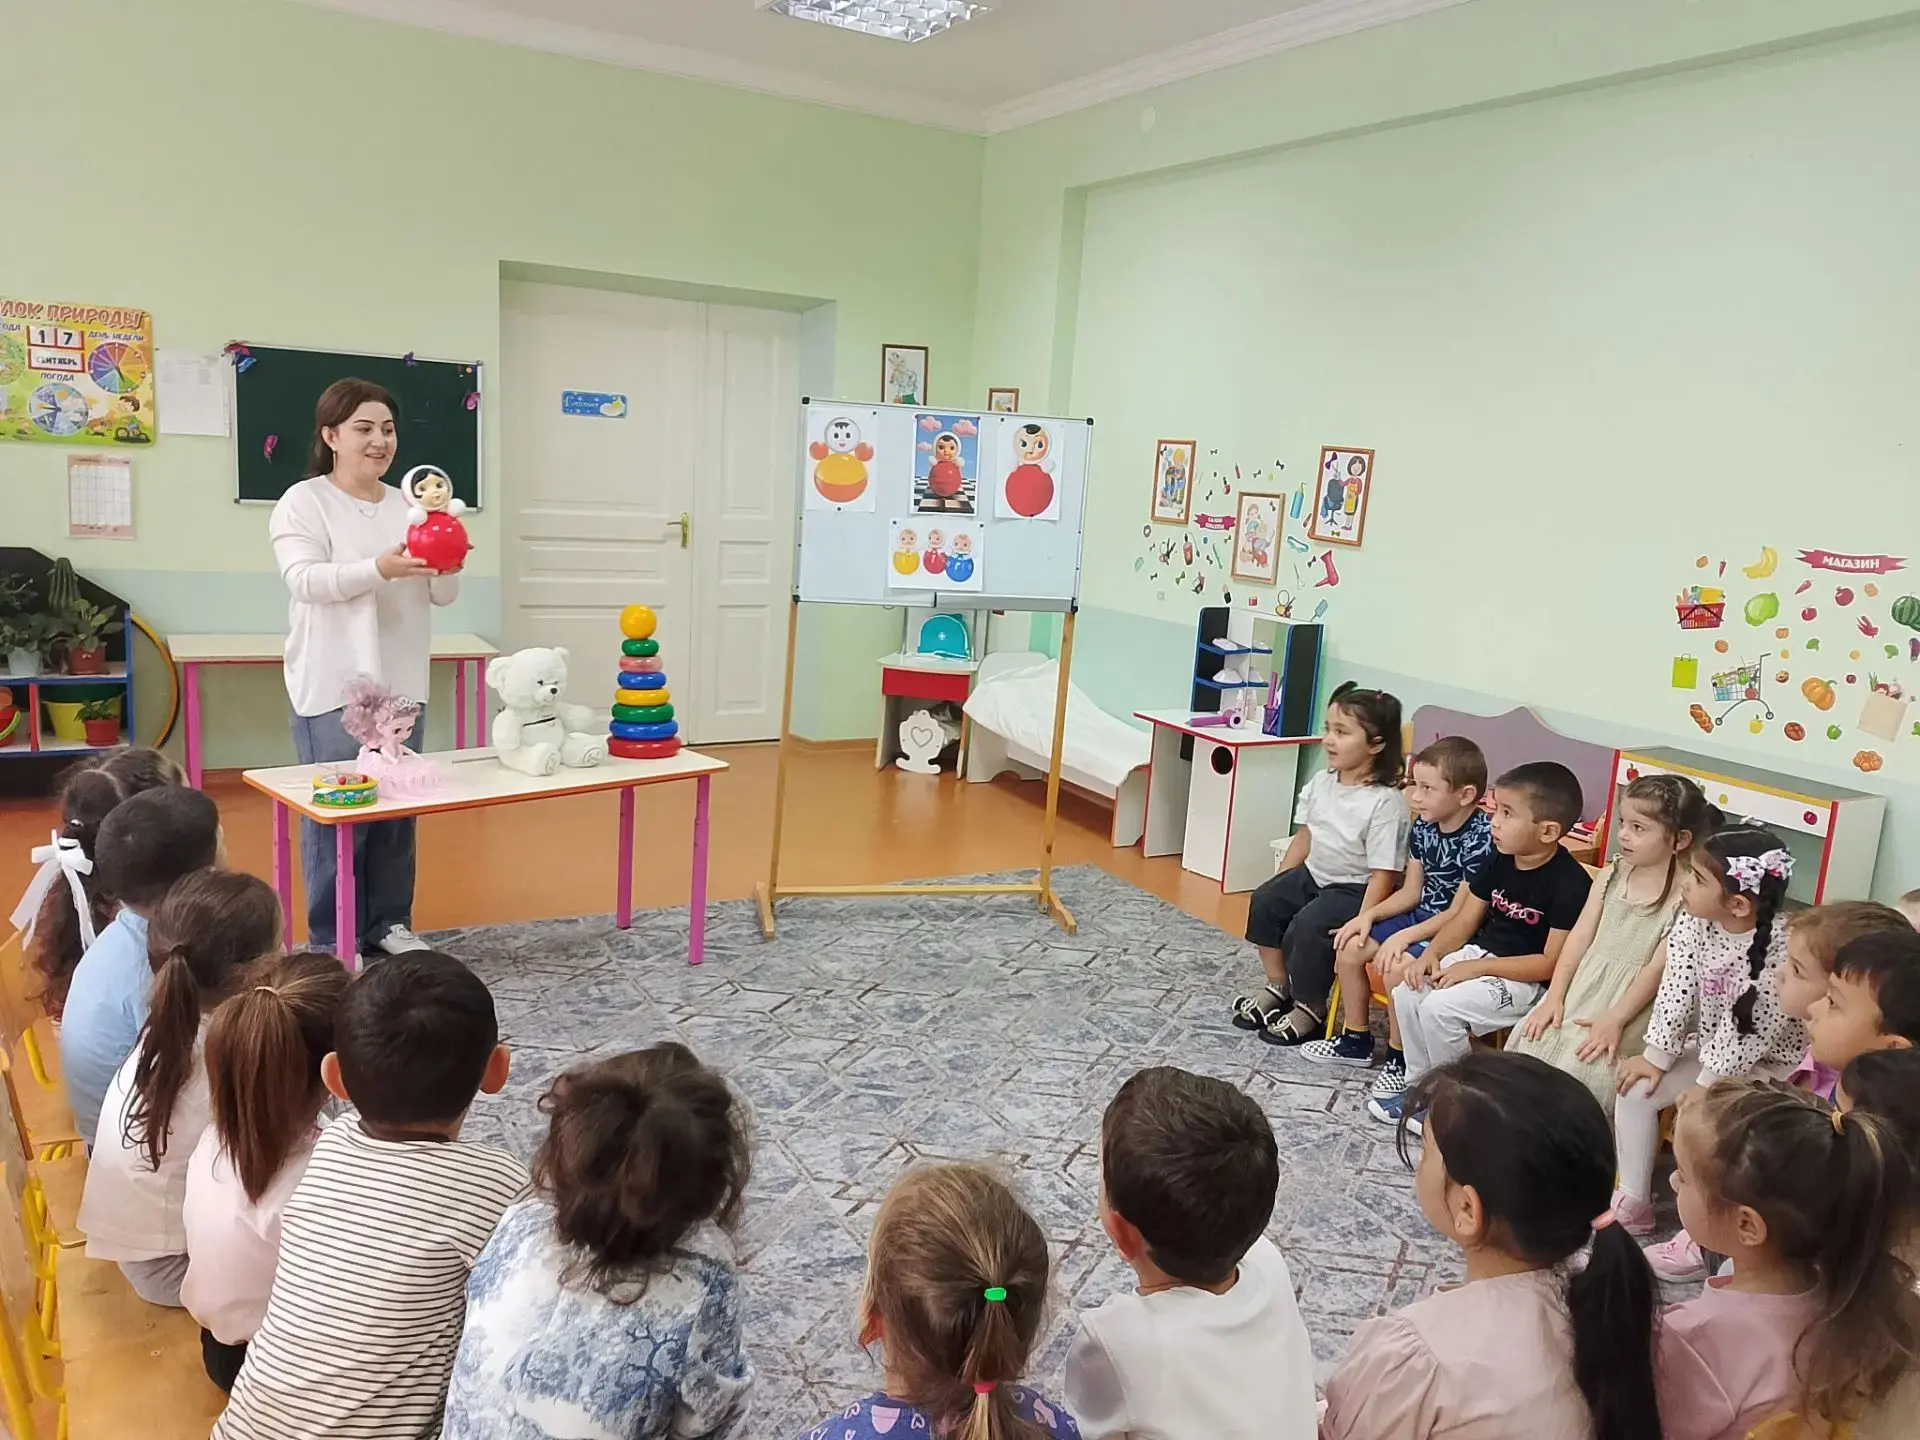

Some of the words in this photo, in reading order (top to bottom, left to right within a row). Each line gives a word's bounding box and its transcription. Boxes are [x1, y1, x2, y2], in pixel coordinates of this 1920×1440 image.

[0, 300, 43, 319] ЛОК
[47, 304, 142, 329] ПРИРОДЫ
[39, 329, 46, 344] 1
[63, 331, 73, 346] 7
[88, 331, 110, 340] ДЕНЬ
[112, 333, 144, 342] НЕДЕЛИ
[40, 372, 75, 382] ПОГОДА
[1822, 555, 1880, 569] МАГАЗИН
